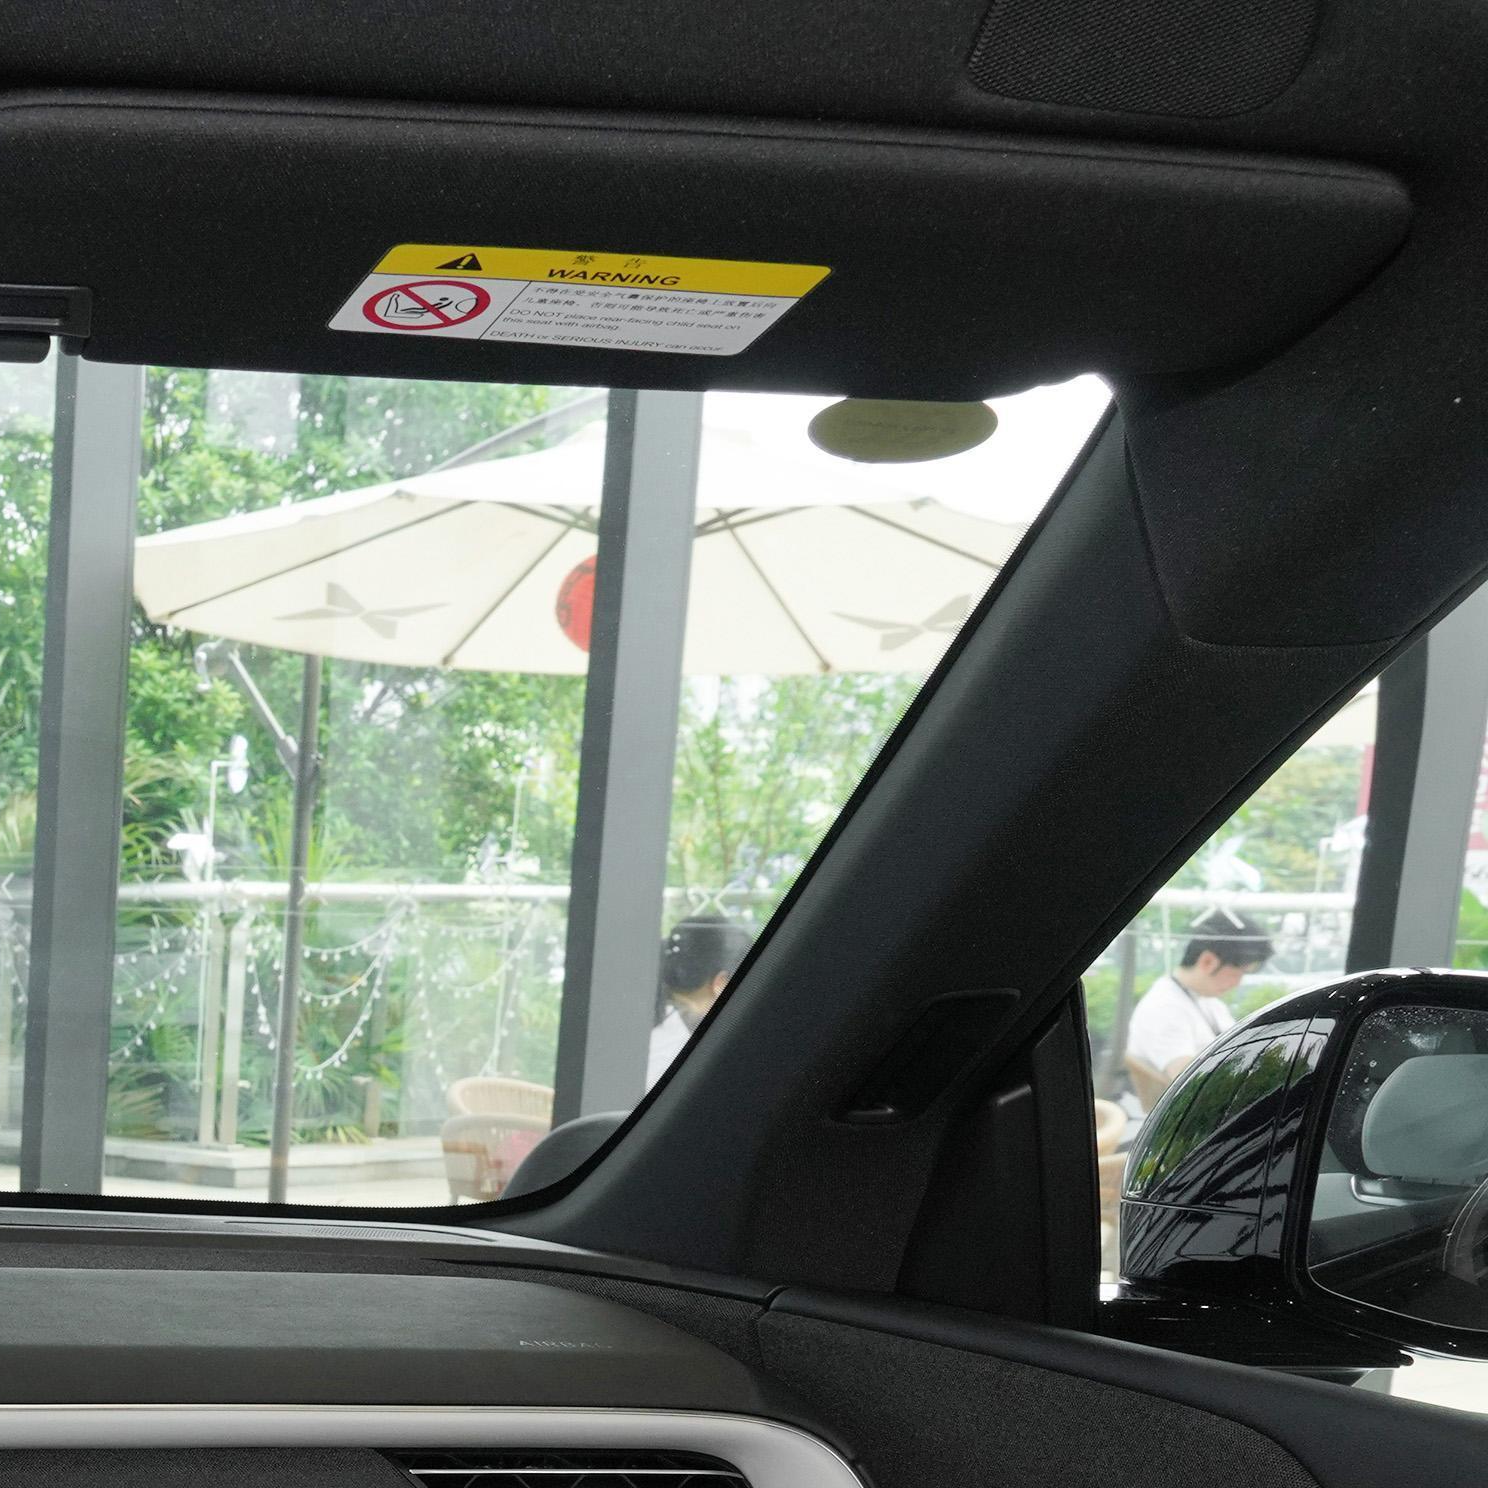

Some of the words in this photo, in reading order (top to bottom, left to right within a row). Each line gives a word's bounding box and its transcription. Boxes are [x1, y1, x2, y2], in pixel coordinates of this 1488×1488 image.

[546, 268, 682, 285] WARNING
[509, 308, 532, 316] DO
[532, 310, 564, 318] NOT
[563, 312, 598, 321] place
[599, 315, 665, 327] rear-facing
[665, 319, 697, 329] child
[696, 322, 725, 330] seat
[525, 317, 553, 325] seat
[553, 319, 580, 328] with
[580, 322, 620, 332] airbag
[489, 330, 536, 338] DEATH
[551, 334, 614, 345] SERIOUS
[614, 339, 664, 348] INJURY
